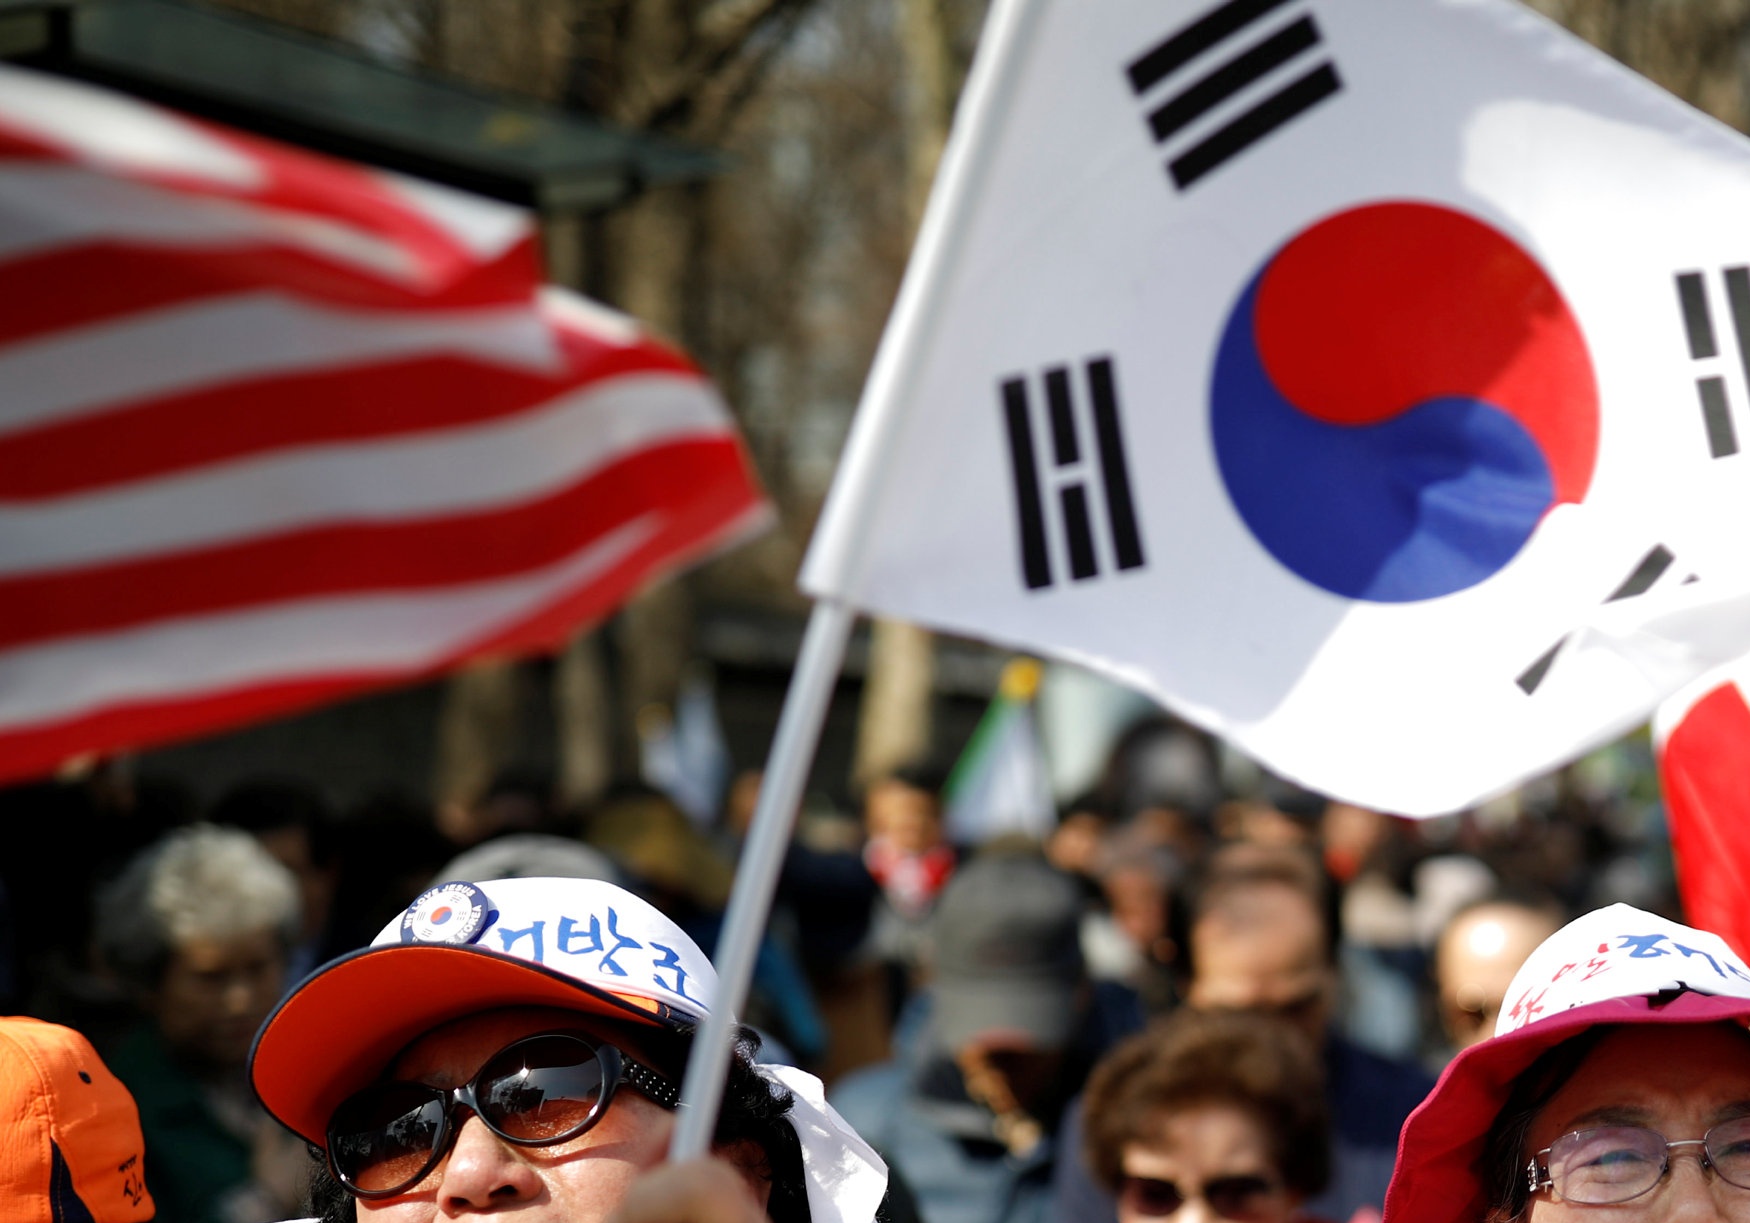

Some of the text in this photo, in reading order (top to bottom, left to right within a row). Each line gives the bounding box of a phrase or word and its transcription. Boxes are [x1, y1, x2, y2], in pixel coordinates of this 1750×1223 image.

[411, 887, 440, 911] LOVE
[442, 883, 477, 898] JESUS
[456, 904, 483, 940] KOREA
